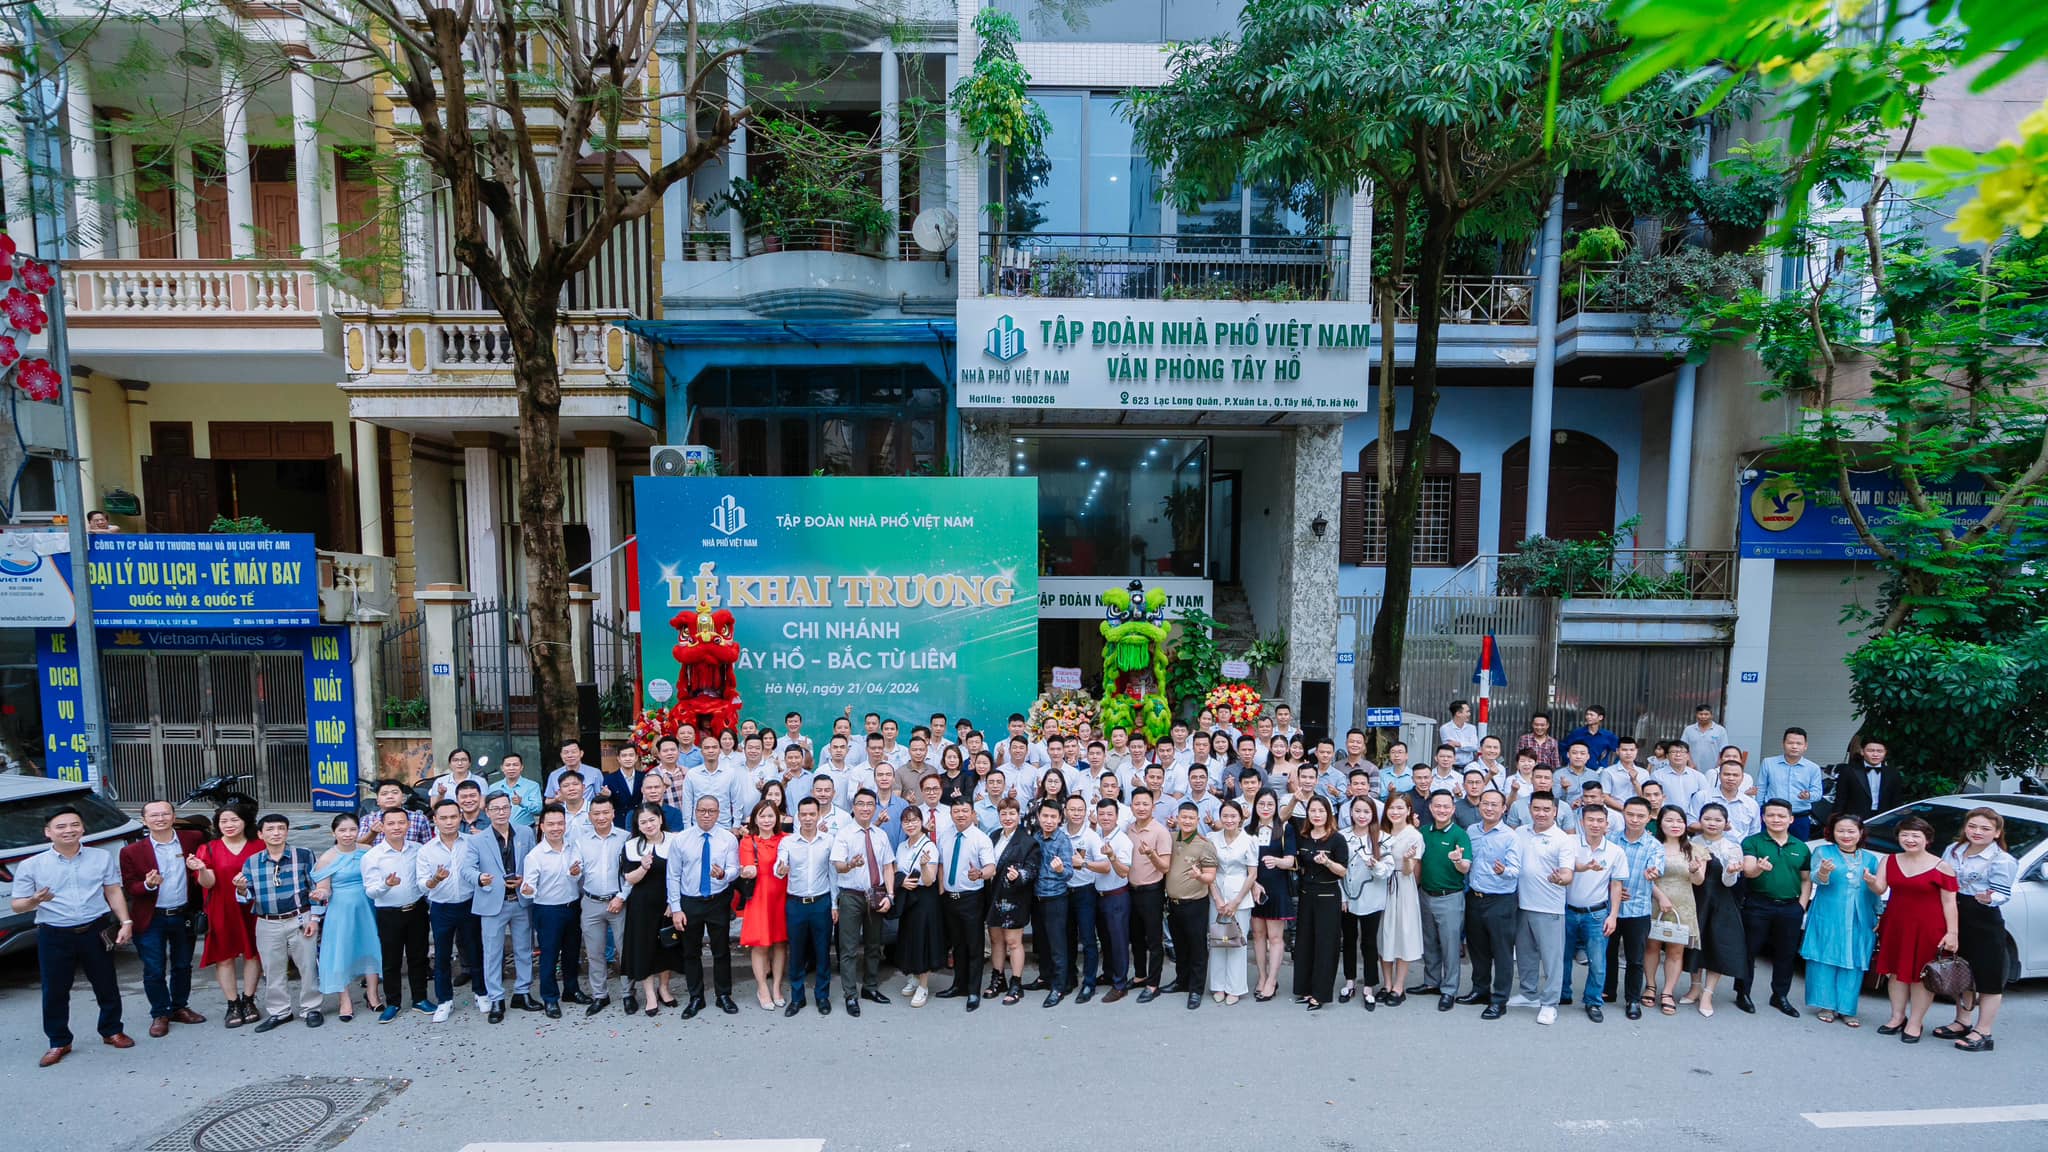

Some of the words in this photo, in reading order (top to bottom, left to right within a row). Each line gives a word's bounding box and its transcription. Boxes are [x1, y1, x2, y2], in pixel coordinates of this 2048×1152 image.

[1040, 314, 1084, 349] TẬP
[1092, 316, 1154, 346] ĐOÀN
[1161, 316, 1208, 346] NHÀ
[1215, 313, 1260, 346] PHỐ
[1265, 318, 1312, 351] VIỆT
[1318, 323, 1370, 347] NAM
[961, 367, 985, 384] NHÀ
[988, 364, 1011, 384] PHỐ
[1015, 367, 1040, 386] VIỆT
[1044, 370, 1070, 385] NAM
[1107, 353, 1148, 380] VĂN
[1155, 353, 1224, 381] PHÒNG
[1232, 354, 1267, 381] TÂY
[1275, 351, 1301, 381] HỒ
[969, 394, 1006, 404] Hotline:
[1132, 396, 1149, 405] 623
[1154, 396, 1170, 407] Lạc
[1172, 396, 1193, 406] Long
[1343, 398, 1358, 408] Nội
[1874, 490, 1884, 505] DI
[1956, 491, 1982, 506] KHOA
[776, 513, 801, 530] TẬP
[804, 513, 844, 528] ĐOÀN
[849, 513, 878, 528] NHÀ
[880, 511, 909, 528] PHỐ
[912, 514, 941, 531] VIỆT
[943, 516, 974, 528] NAM
[94, 539, 115, 550] CÔNG
[116, 541, 125, 550] TY
[127, 541, 137, 550] CP
[215, 539, 225, 550] VÀ
[239, 541, 255, 552] LỊCH
[257, 539, 273, 552] VIỆT
[275, 541, 291, 551] ANH
[702, 537, 715, 547] NHÀ
[716, 536, 729, 547] PHỐ
[729, 538, 742, 548] VIỆT
[744, 538, 758, 547] NAM
[88, 562, 113, 590] ĐẠI
[116, 557, 133, 585] LÝ
[138, 562, 159, 585] DU
[162, 562, 197, 590] LỊCH
[211, 557, 230, 585] VÉ
[234, 557, 267, 585] MÁY
[272, 562, 301, 585] BAY
[666, 561, 722, 607] LỄ
[727, 575, 833, 607] KHAI
[838, 572, 1015, 608] TRƯƠNG
[129, 591, 162, 607] QUỐC
[166, 592, 187, 609] NỘI
[191, 595, 200, 606] &
[204, 591, 237, 607] QUỐC
[240, 591, 255, 606] TẾ
[1059, 592, 1096, 607] ĐOÀN
[1172, 595, 1204, 607] NAM
[210, 632, 264, 646] Airlines
[782, 621, 819, 639] CHI
[826, 617, 900, 639] NHÁNH
[51, 633, 67, 653] XE
[311, 636, 339, 661] VISA
[736, 648, 767, 669] ÂY
[773, 645, 805, 669] HỒ
[828, 645, 872, 669] BẮC
[878, 647, 905, 669] TỪ
[911, 648, 957, 669] LIÊM
[49, 667, 79, 690] DỊCH
[434, 665, 448, 673] 619
[313, 669, 342, 702] XUẤT
[765, 682, 782, 695] Hà
[786, 682, 809, 696] Nội,
[812, 683, 845, 696] ngày
[847, 682, 920, 695] 21/04/2024
[58, 700, 75, 724] VỤ
[48, 734, 57, 752] 4
[71, 733, 87, 752] 45
[315, 715, 346, 749] NHẬP
[58, 759, 83, 783] CHỖ
[318, 754, 349, 784] CẢNH
